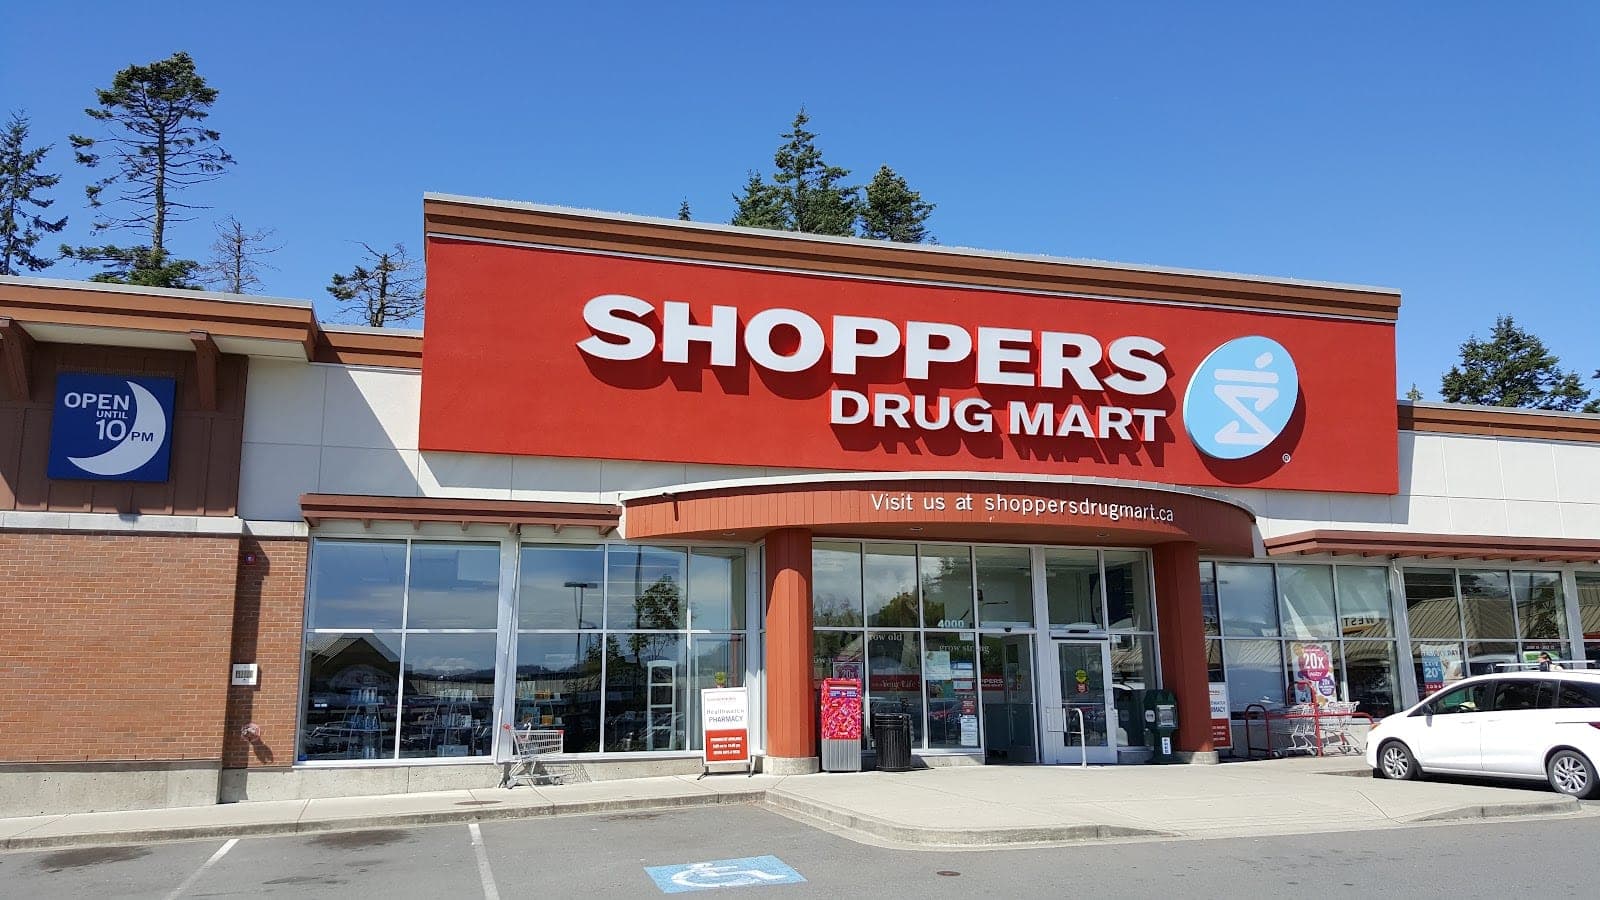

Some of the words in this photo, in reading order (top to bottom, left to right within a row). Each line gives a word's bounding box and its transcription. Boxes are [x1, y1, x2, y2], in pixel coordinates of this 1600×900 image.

[576, 294, 1168, 396] SHOPPERS
[64, 392, 130, 411] OPEN
[96, 410, 129, 419] UNTIL
[830, 389, 993, 433] DRUG
[1009, 401, 1167, 442] MART
[96, 419, 128, 441] 10
[130, 431, 154, 442] PM
[870, 493, 914, 511] Visit
[923, 497, 946, 510] us
[955, 493, 973, 511] at
[984, 493, 1174, 522] shoppersdrugmart.ca
[937, 620, 965, 628] 4000
[1303, 652, 1325, 669] 20x
[708, 715, 744, 723] PHARMACY
